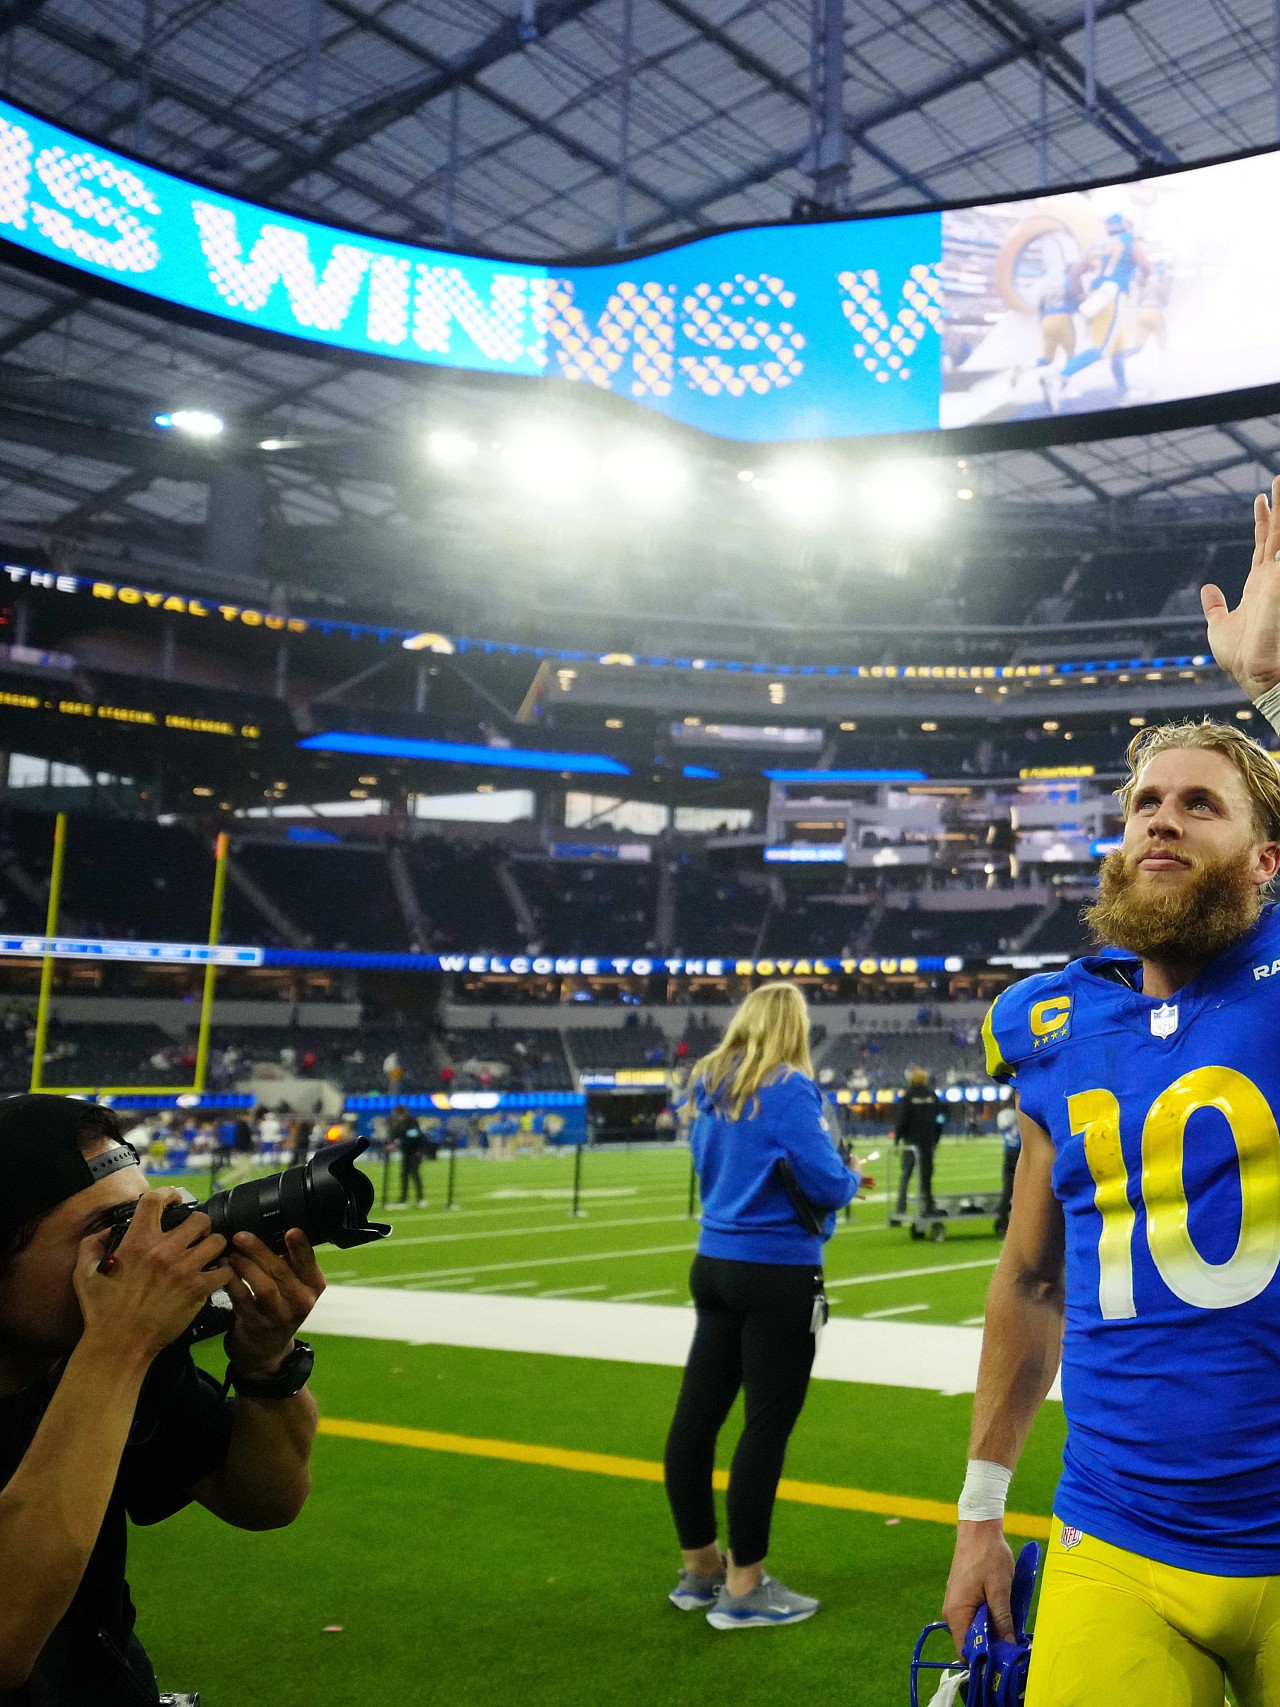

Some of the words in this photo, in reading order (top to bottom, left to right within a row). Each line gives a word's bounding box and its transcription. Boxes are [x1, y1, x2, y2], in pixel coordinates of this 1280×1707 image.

[4, 565, 79, 594] THE
[92, 581, 209, 618] ROYAL
[218, 604, 309, 634] TOUR
[858, 666, 899, 679] LOS
[904, 665, 997, 679] ANGELES
[438, 955, 599, 975] WELCOME
[611, 958, 652, 976] TO
[665, 959, 723, 976] THE
[735, 959, 831, 976] ROYAL
[840, 958, 918, 975] TOUR
[1030, 996, 1071, 1037] C
[262, 1209, 281, 1218] SONY
